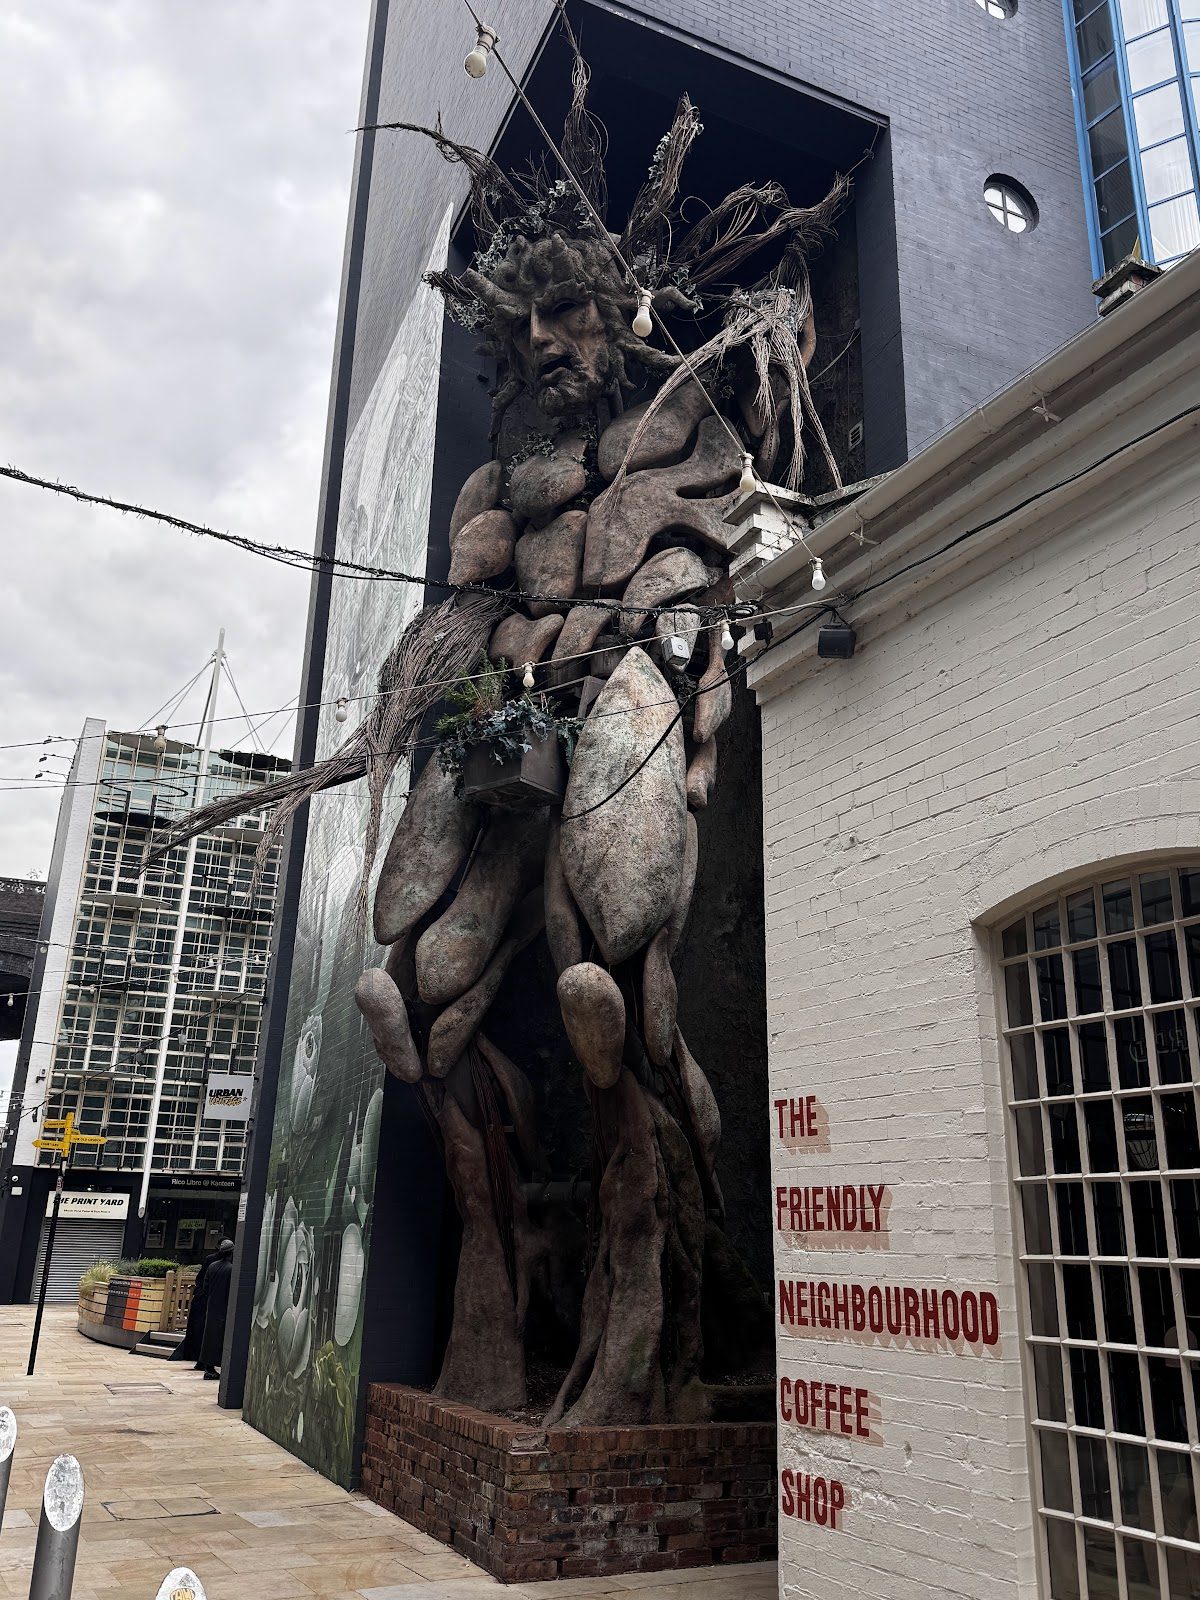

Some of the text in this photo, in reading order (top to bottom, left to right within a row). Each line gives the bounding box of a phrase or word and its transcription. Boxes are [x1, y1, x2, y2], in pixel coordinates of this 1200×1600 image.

[209, 1088, 244, 1097] URBAN
[774, 1095, 818, 1139] THE
[53, 1197, 124, 1206] HE PRINT YARD
[776, 1184, 885, 1231] FRIENDLY
[779, 1279, 999, 1345] NEIGHBOURHOOD
[780, 1376, 870, 1437] COFFEE
[781, 1468, 844, 1529] SHOP
